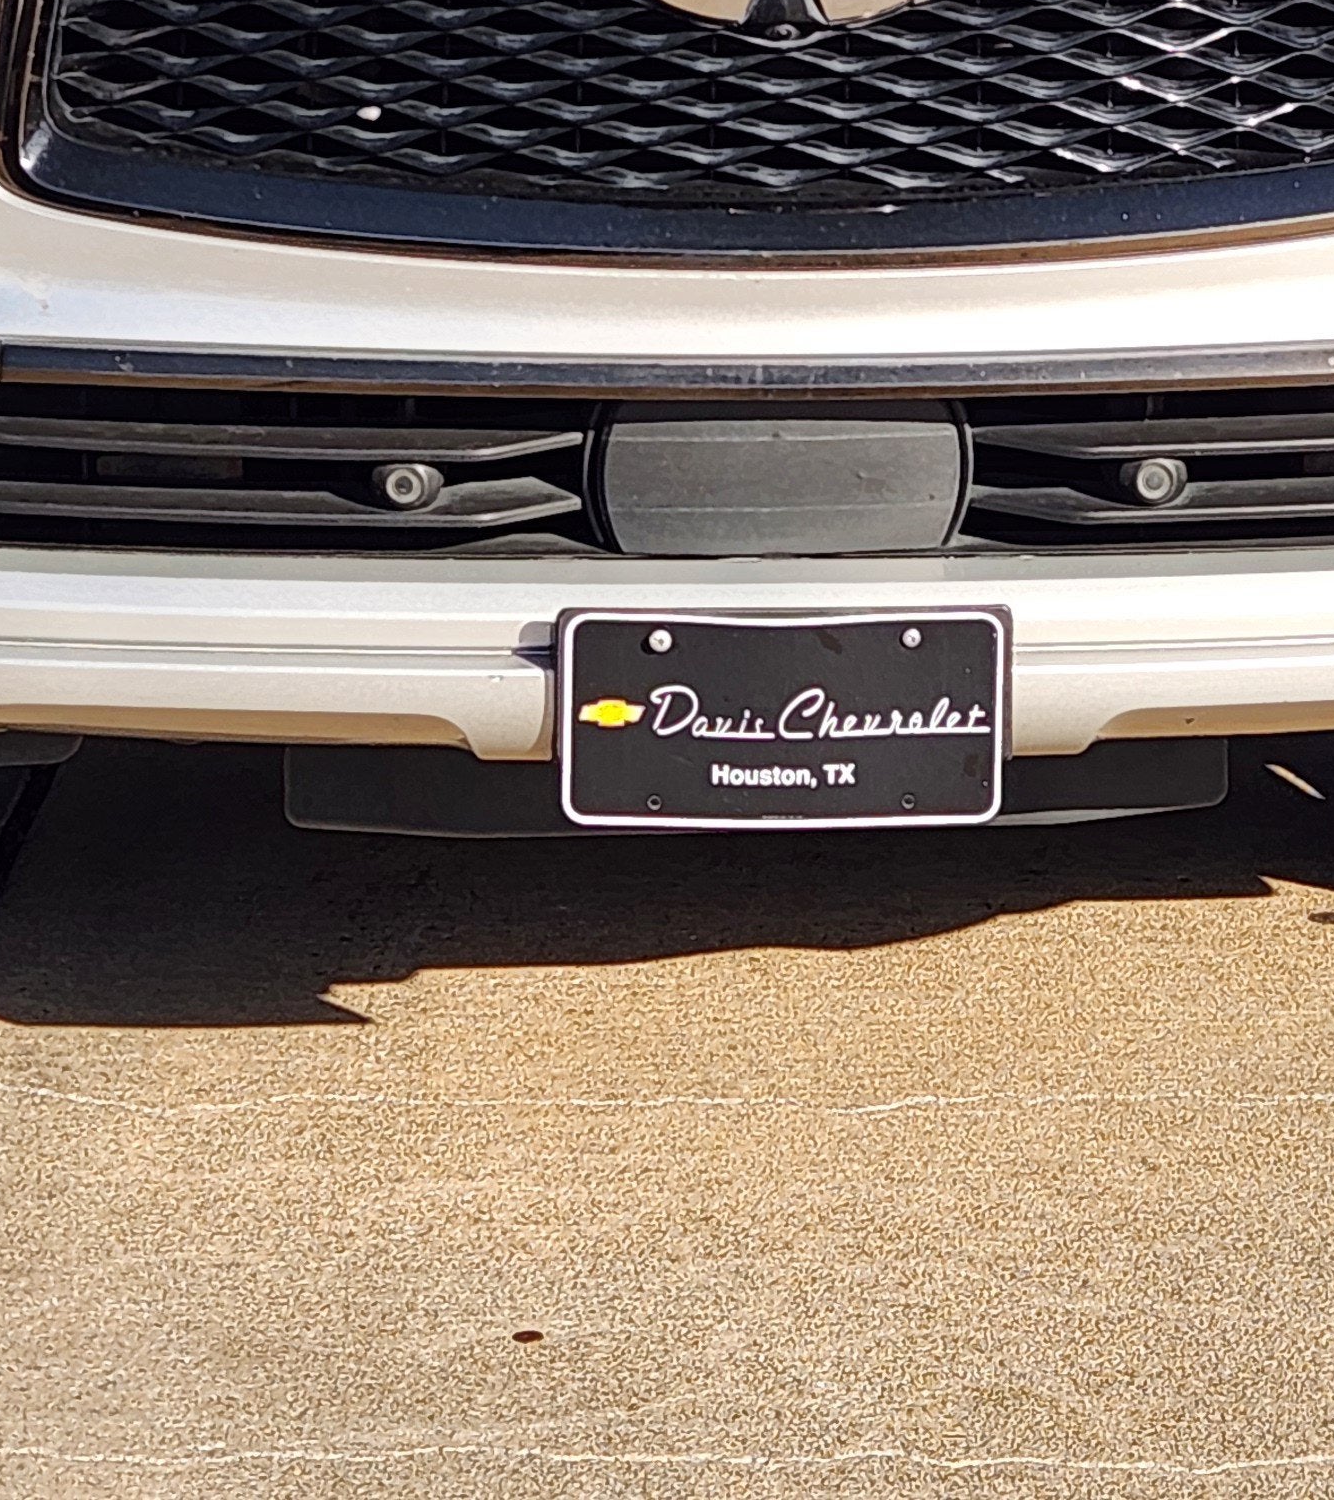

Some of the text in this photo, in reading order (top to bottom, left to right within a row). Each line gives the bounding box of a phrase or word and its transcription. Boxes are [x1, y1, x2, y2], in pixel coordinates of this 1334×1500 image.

[649, 684, 990, 739] Davis Chevrolet
[711, 762, 856, 789] Houston, TX
